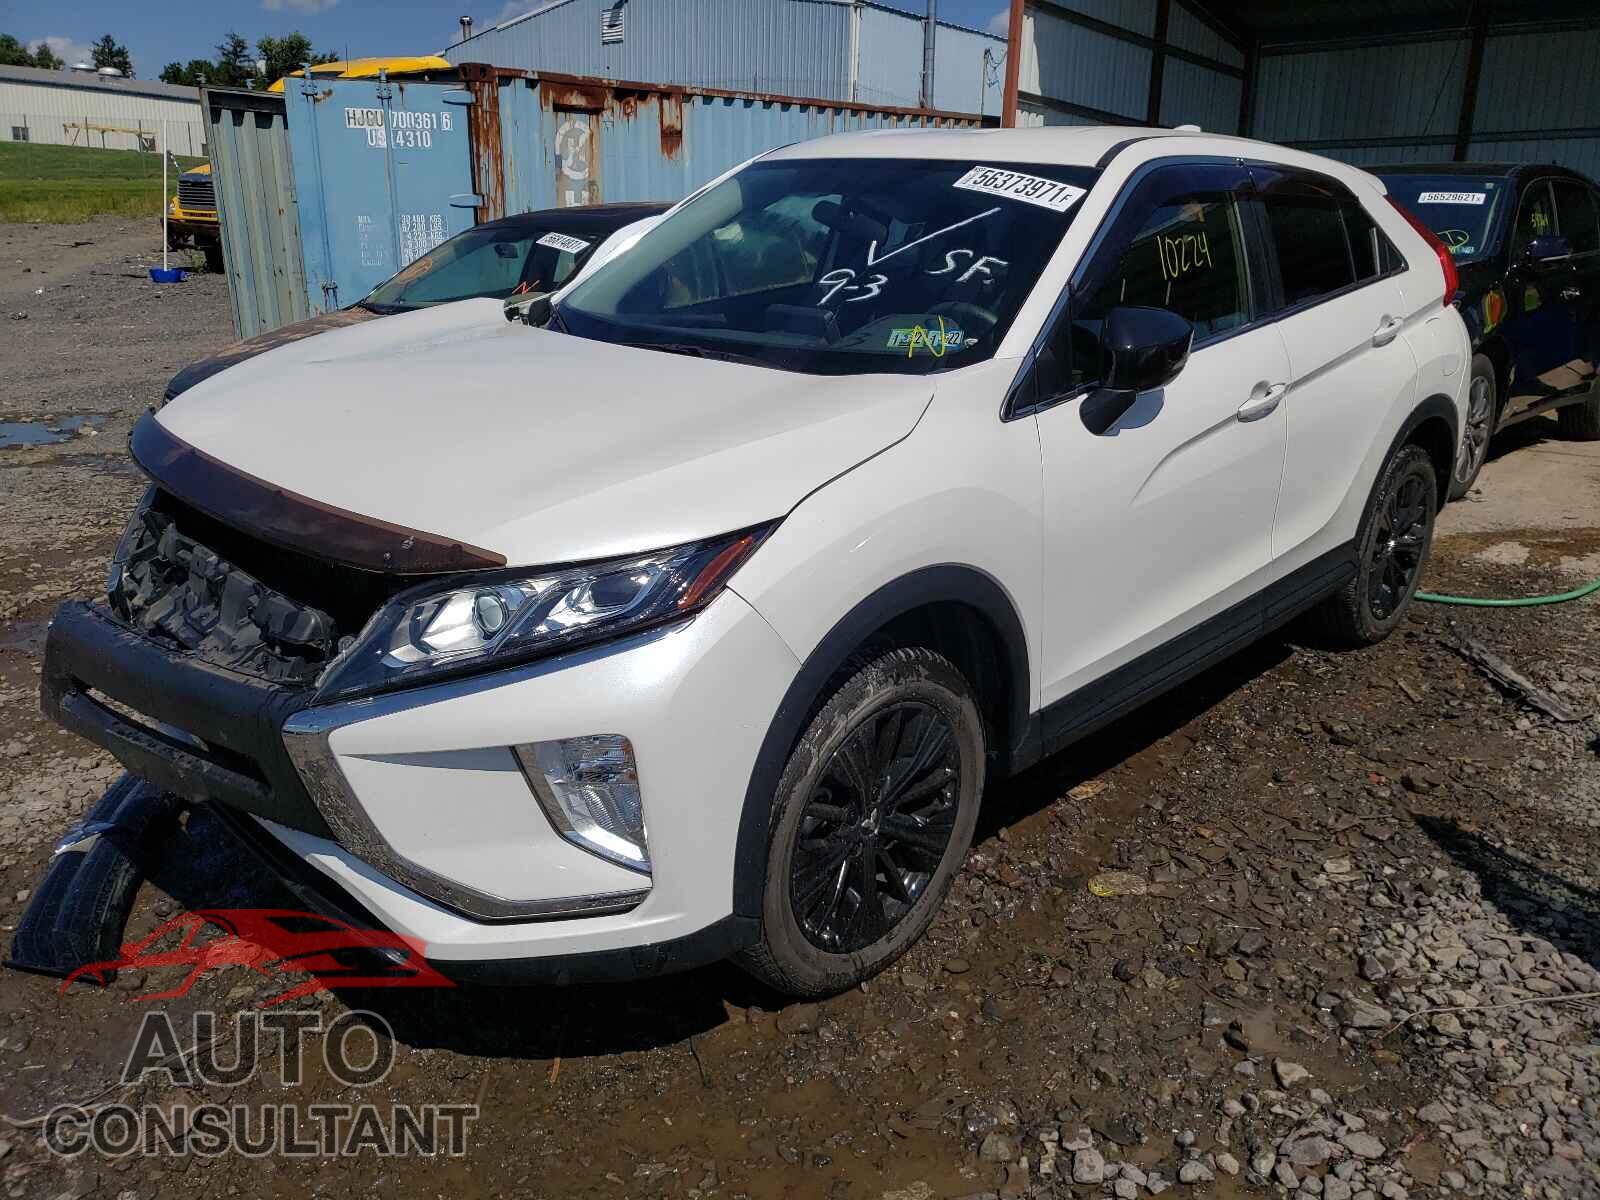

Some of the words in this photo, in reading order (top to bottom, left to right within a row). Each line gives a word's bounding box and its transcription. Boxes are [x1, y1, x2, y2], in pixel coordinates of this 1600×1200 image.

[392, 112, 437, 128] 700361
[396, 131, 431, 147] 4310
[973, 169, 1068, 202] 56373971
[1156, 231, 1212, 280] 10224
